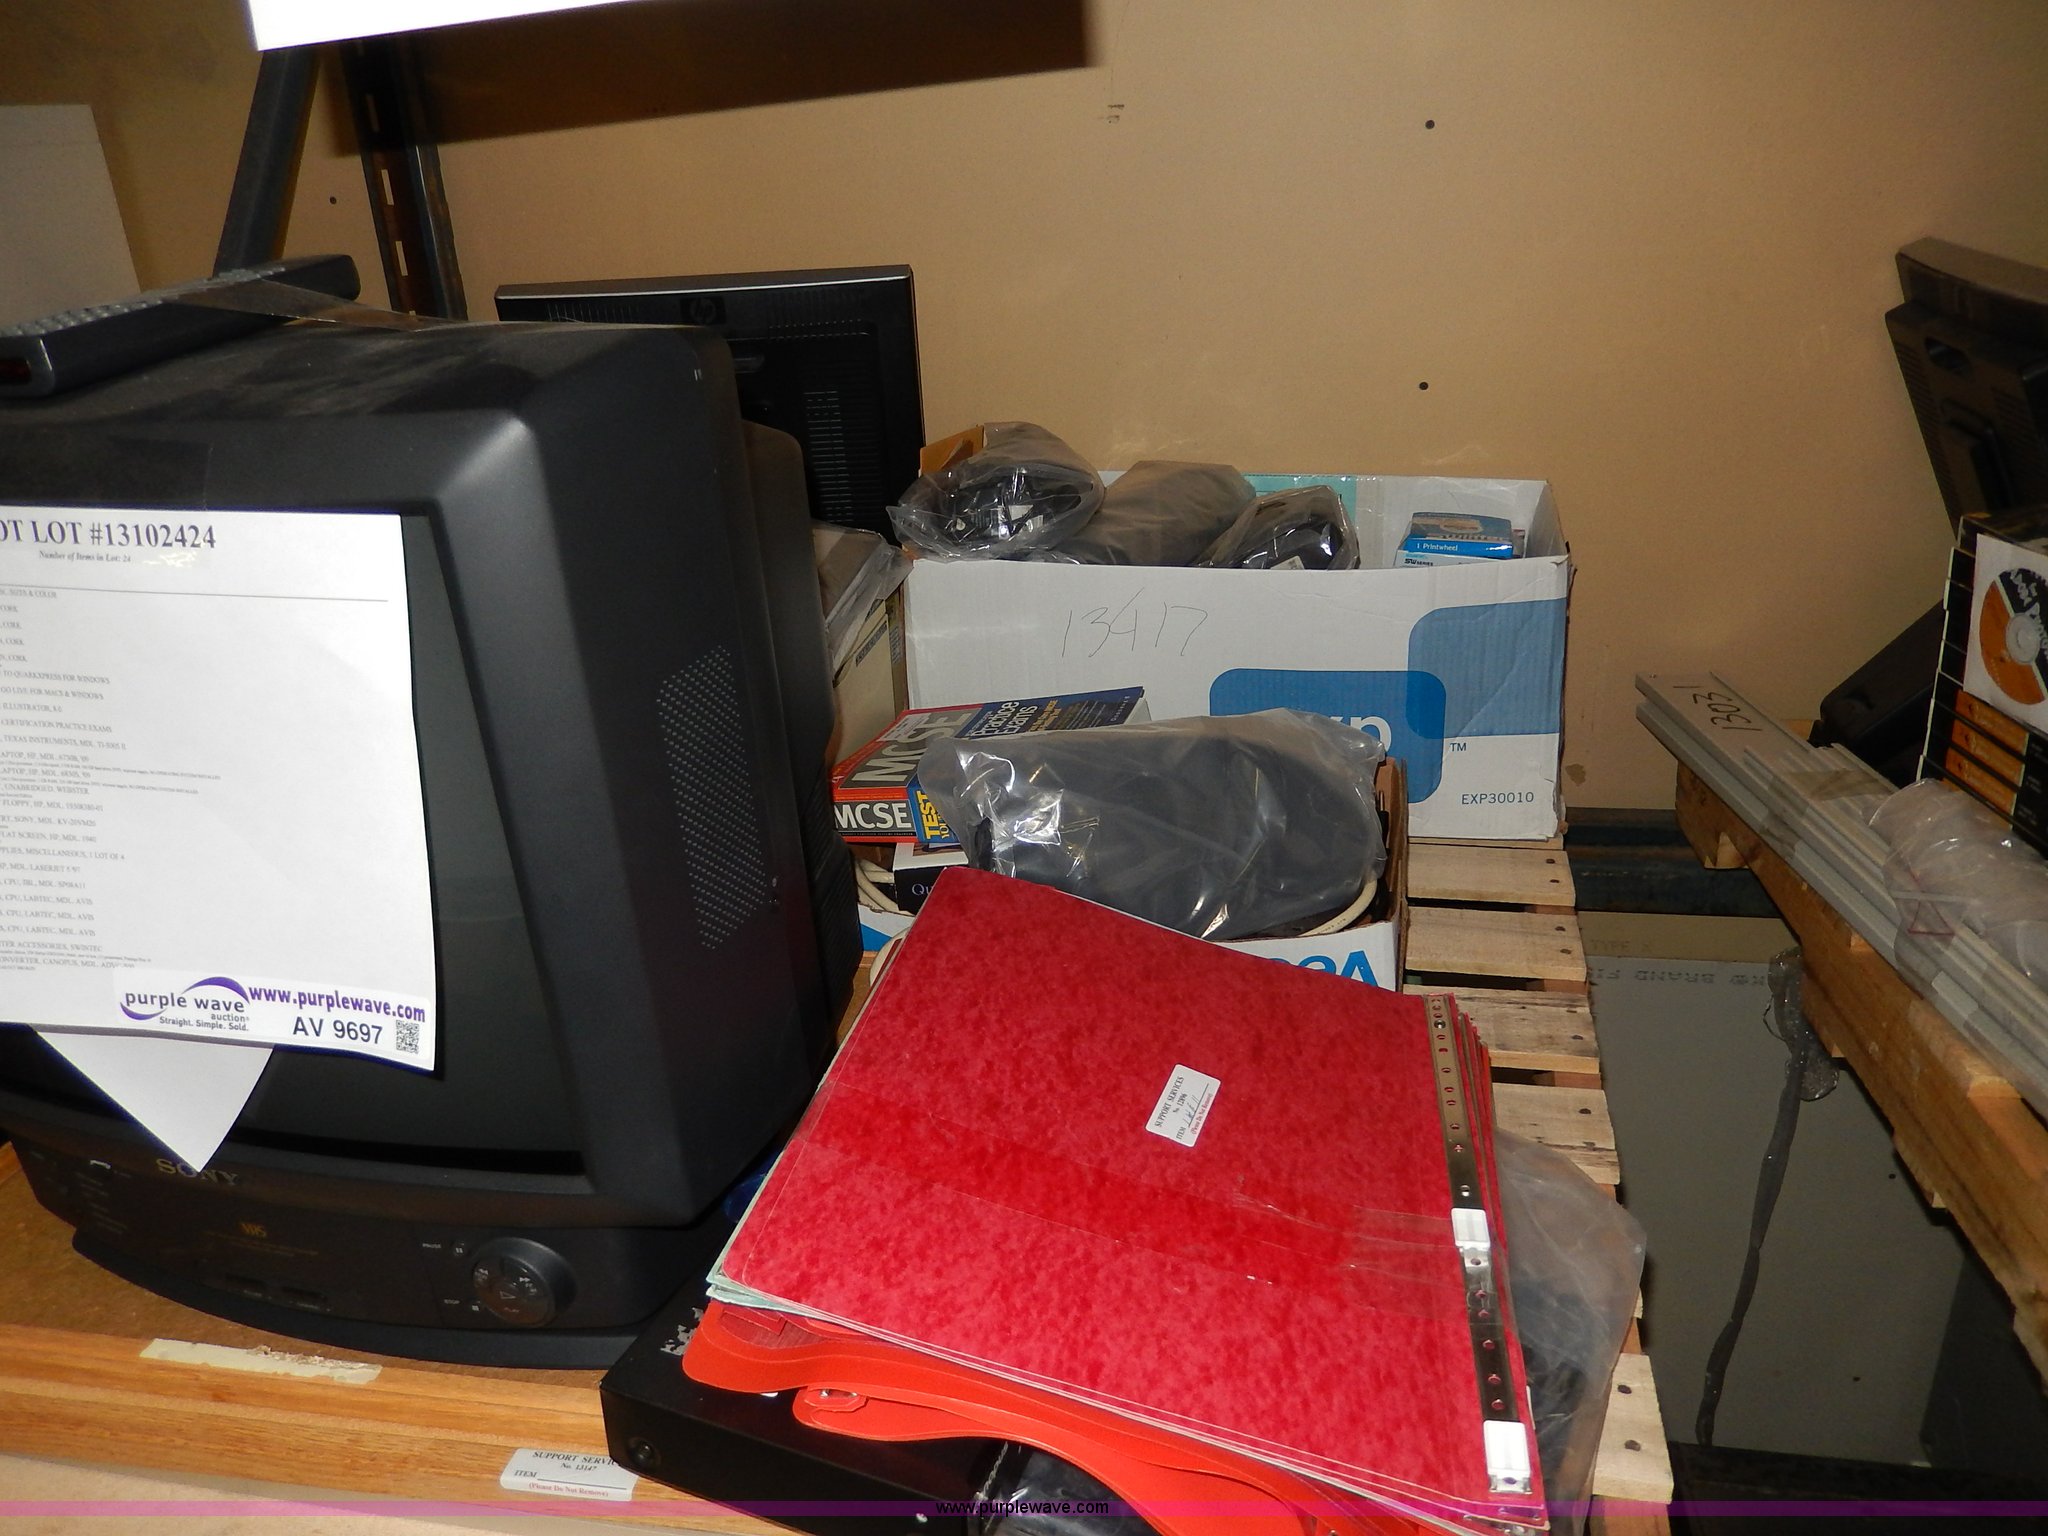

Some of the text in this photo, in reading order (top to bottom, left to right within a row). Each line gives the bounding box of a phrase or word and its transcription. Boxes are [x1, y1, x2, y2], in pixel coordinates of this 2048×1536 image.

[30, 519, 82, 545] LOT
[89, 521, 216, 549] #13102424
[1423, 543, 1458, 552] Printwheel
[1061, 586, 1208, 658] 13417
[851, 709, 974, 782] MCSE
[1461, 790, 1535, 806] EXP30010
[834, 802, 912, 829] MCSE
[916, 790, 942, 840] TEST
[125, 991, 246, 1014] purple wave
[249, 986, 426, 1023] www.purplewave.com
[159, 1016, 250, 1032] Straight. Simple. Sold.
[292, 1016, 383, 1045] AV 9697
[532, 1451, 580, 1462] SUPPORT
[513, 1469, 538, 1478] ITEM
